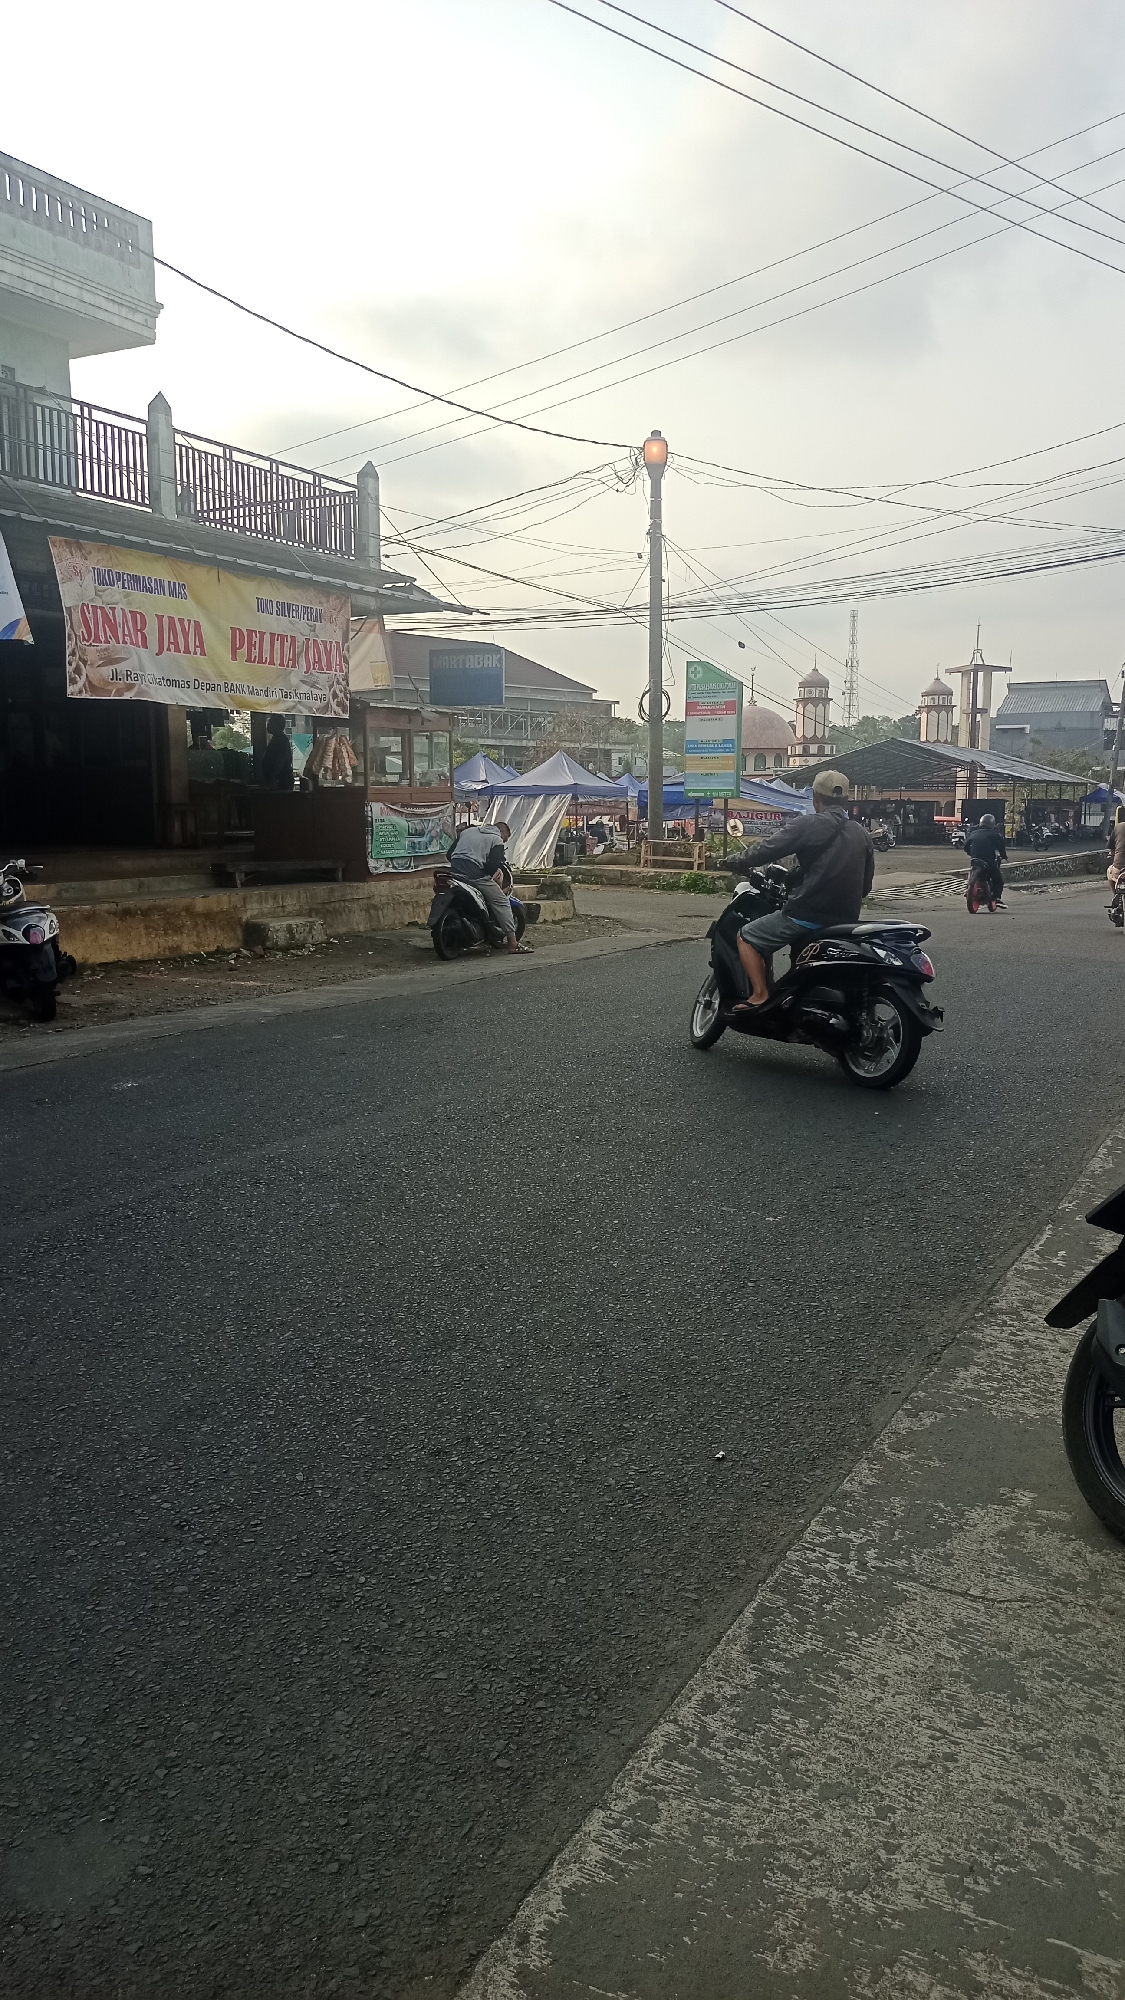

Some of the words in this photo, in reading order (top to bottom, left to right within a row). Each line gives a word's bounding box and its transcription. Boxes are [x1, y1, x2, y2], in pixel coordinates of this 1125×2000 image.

[91, 566, 115, 588] TOKO
[167, 580, 188, 601] MAS
[255, 596, 274, 616] TOKO
[80, 602, 149, 650] SINAR
[155, 613, 207, 657] JAYA
[230, 626, 298, 669] PELITA
[303, 637, 345, 675] JAYA
[432, 654, 501, 669] MARTABAK
[109, 667, 122, 682] Jl.
[193, 678, 222, 694] Depan
[223, 681, 246, 696] BANK
[246, 684, 277, 700] Mandiri
[279, 688, 327, 704] Tasikmalaya
[728, 810, 782, 821] BAJIGUR
